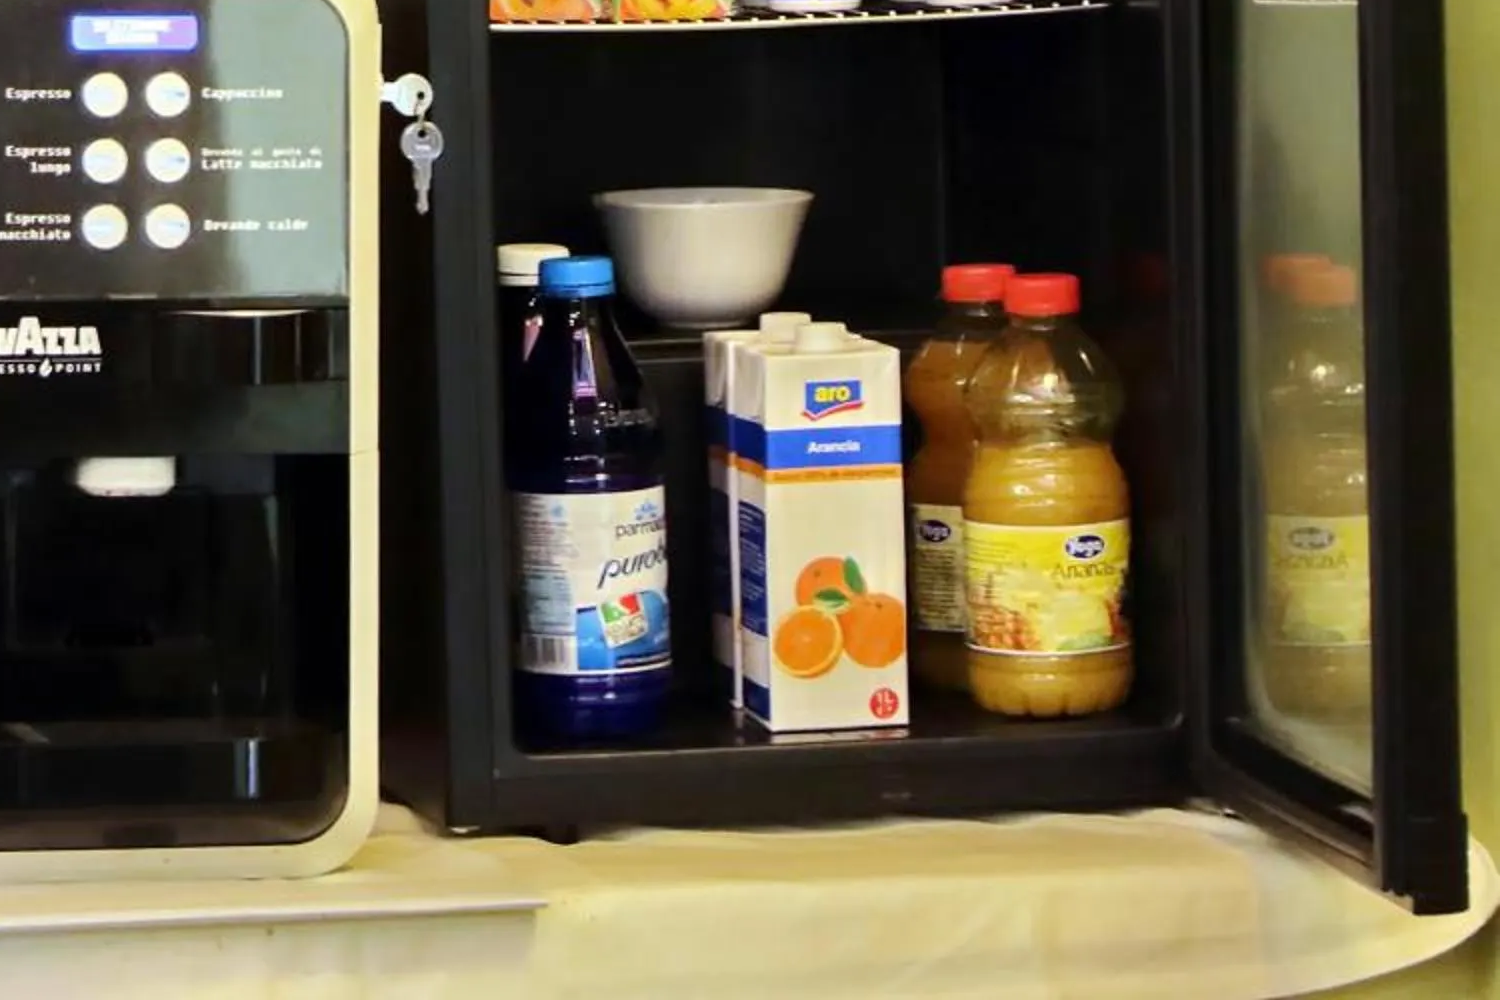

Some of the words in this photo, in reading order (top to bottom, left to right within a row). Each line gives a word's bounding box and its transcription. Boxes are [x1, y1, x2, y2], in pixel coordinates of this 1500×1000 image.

[5, 87, 72, 101] Espresso
[5, 145, 72, 159] Espresso
[5, 212, 72, 227] Espresso
[55, 362, 101, 373] POINT
[814, 386, 851, 402] aro
[806, 440, 861, 454] Arancia
